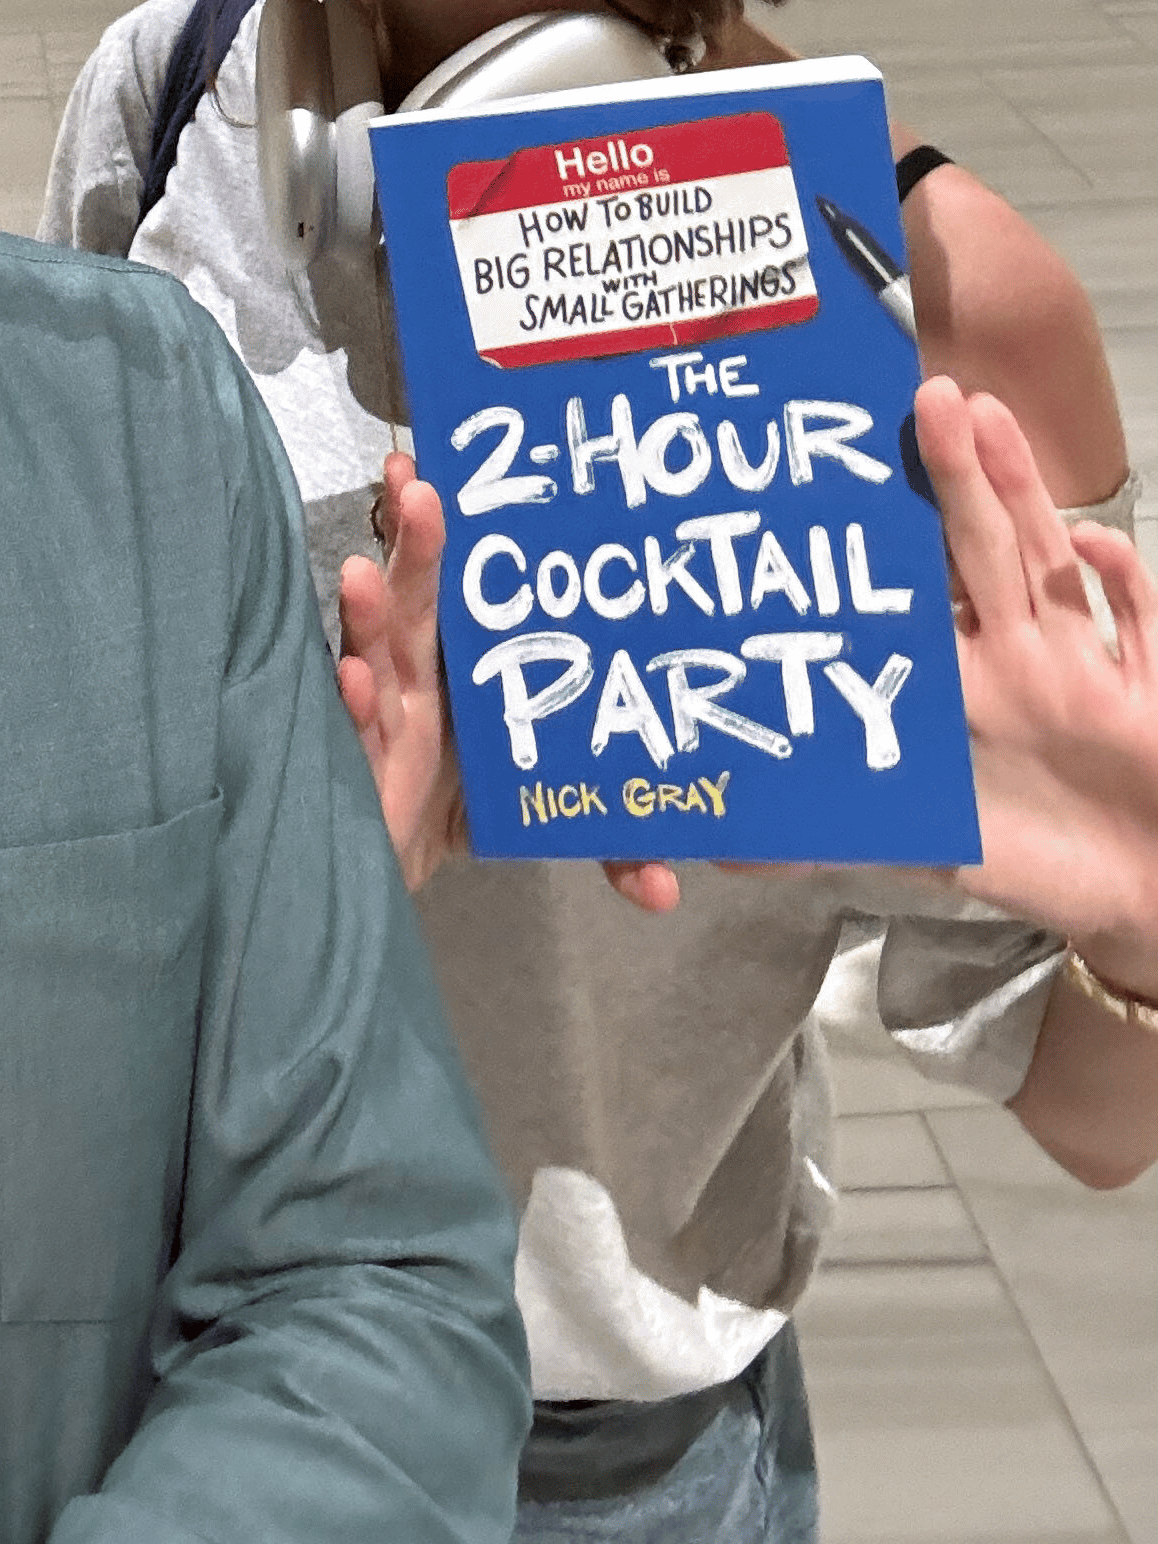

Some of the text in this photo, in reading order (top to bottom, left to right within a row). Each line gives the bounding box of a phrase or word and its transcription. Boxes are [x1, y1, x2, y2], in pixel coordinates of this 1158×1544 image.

[554, 139, 654, 181] Hello
[562, 167, 671, 198] my name is
[518, 185, 713, 247] HOW TO BUILD
[474, 213, 793, 295] BIG RELATIONSHIPS
[602, 271, 658, 294] WITH
[520, 260, 797, 332] SMALL GATHERINGS
[649, 351, 759, 404] THE
[450, 393, 893, 516] 2-HOUR
[462, 510, 915, 631] COCKTAIL
[472, 630, 914, 772] PARTY
[519, 770, 731, 827] NICK GRAY
